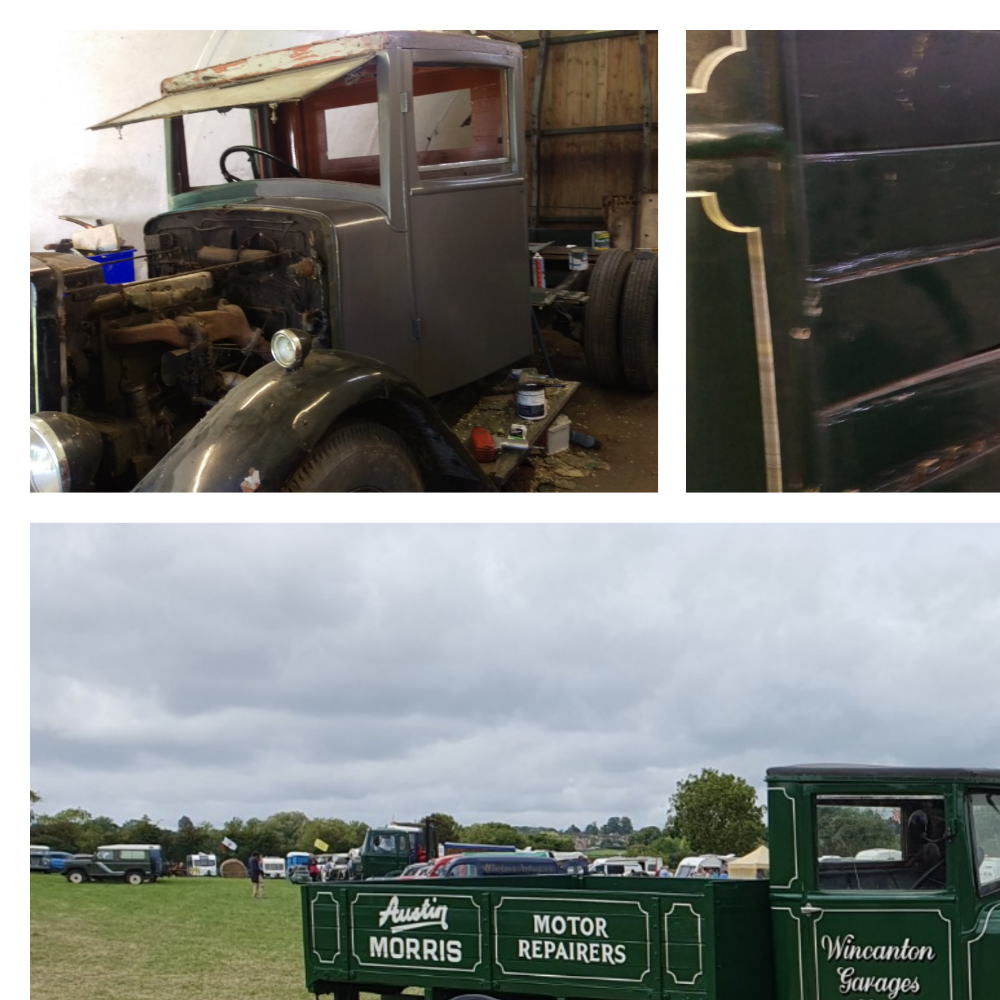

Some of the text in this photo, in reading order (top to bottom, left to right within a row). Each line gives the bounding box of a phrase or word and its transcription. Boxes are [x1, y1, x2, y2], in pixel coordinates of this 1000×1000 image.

[379, 895, 449, 934] Austin
[533, 914, 609, 938] MOTOR
[369, 936, 462, 963] MORRIS
[518, 939, 627, 965] REPAIRERS
[821, 934, 936, 961] Wincanton
[836, 966, 921, 1000] Garages
